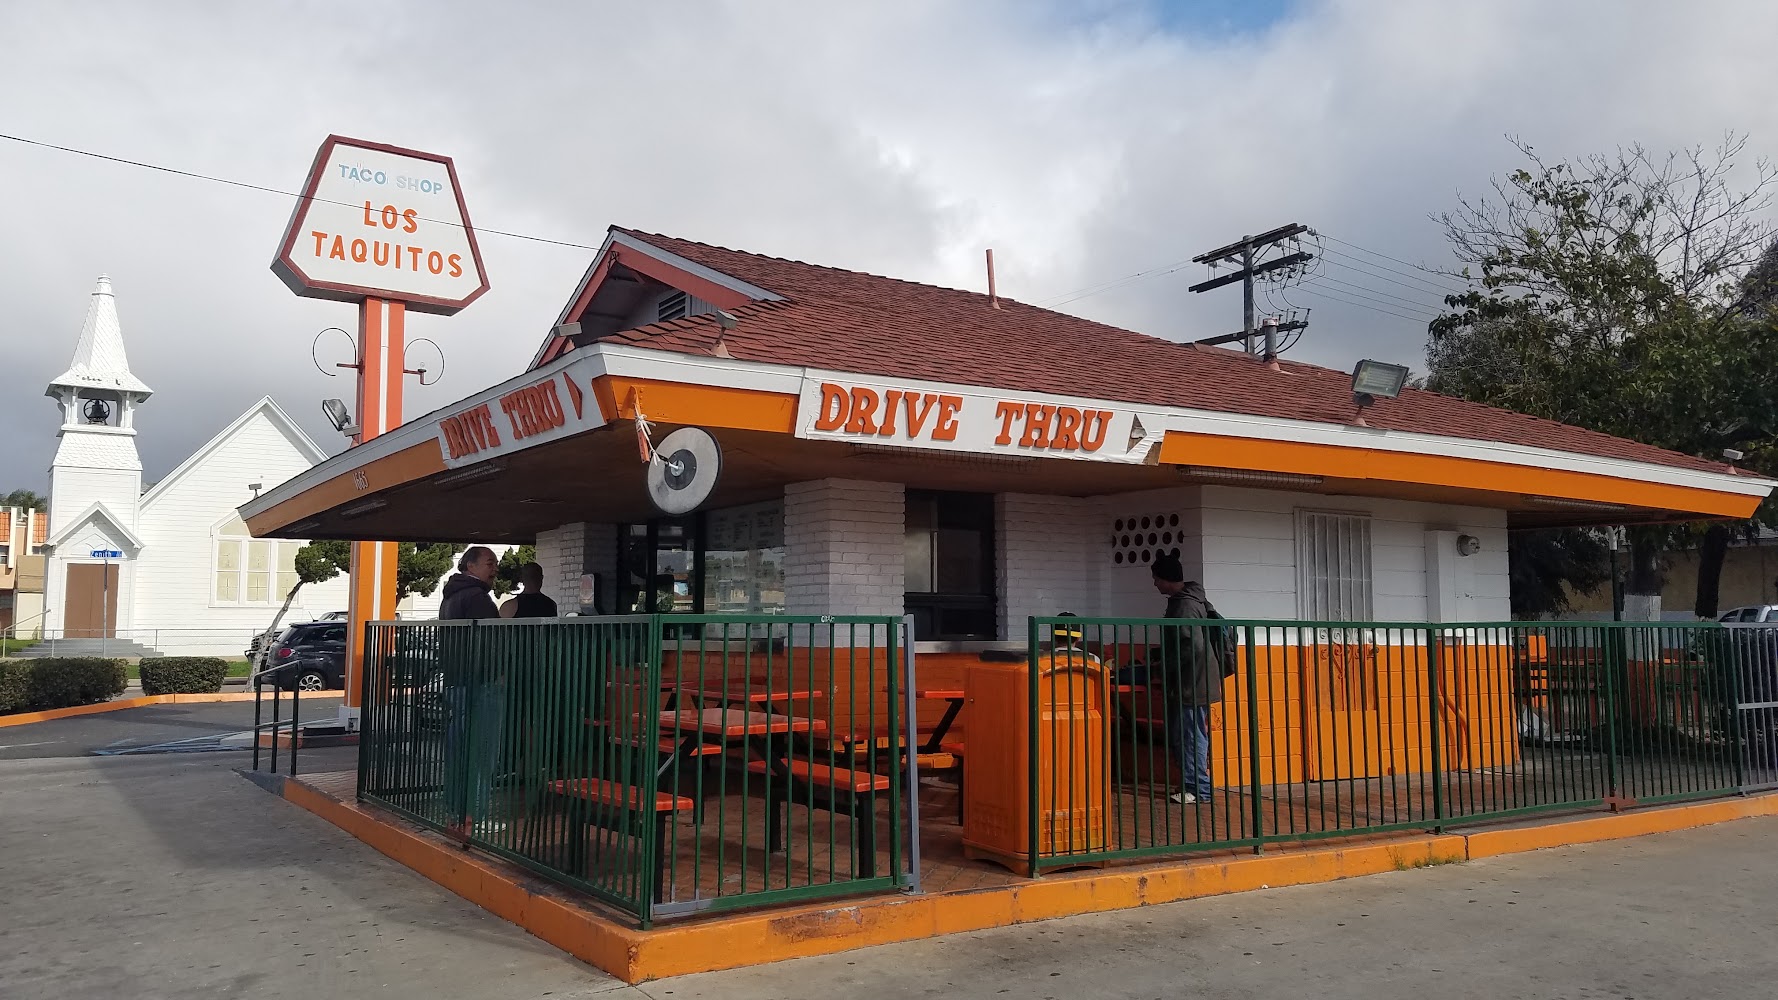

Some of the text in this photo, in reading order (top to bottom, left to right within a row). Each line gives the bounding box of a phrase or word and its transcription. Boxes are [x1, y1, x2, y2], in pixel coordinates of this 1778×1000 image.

[339, 163, 443, 195] TACO SHOP
[364, 201, 418, 233] LOS
[311, 231, 463, 278] TAQUITOS
[439, 379, 565, 460] DRIVE THRU
[815, 383, 1113, 452] DRIVE THRU
[90, 550, 112, 558] Zenith
